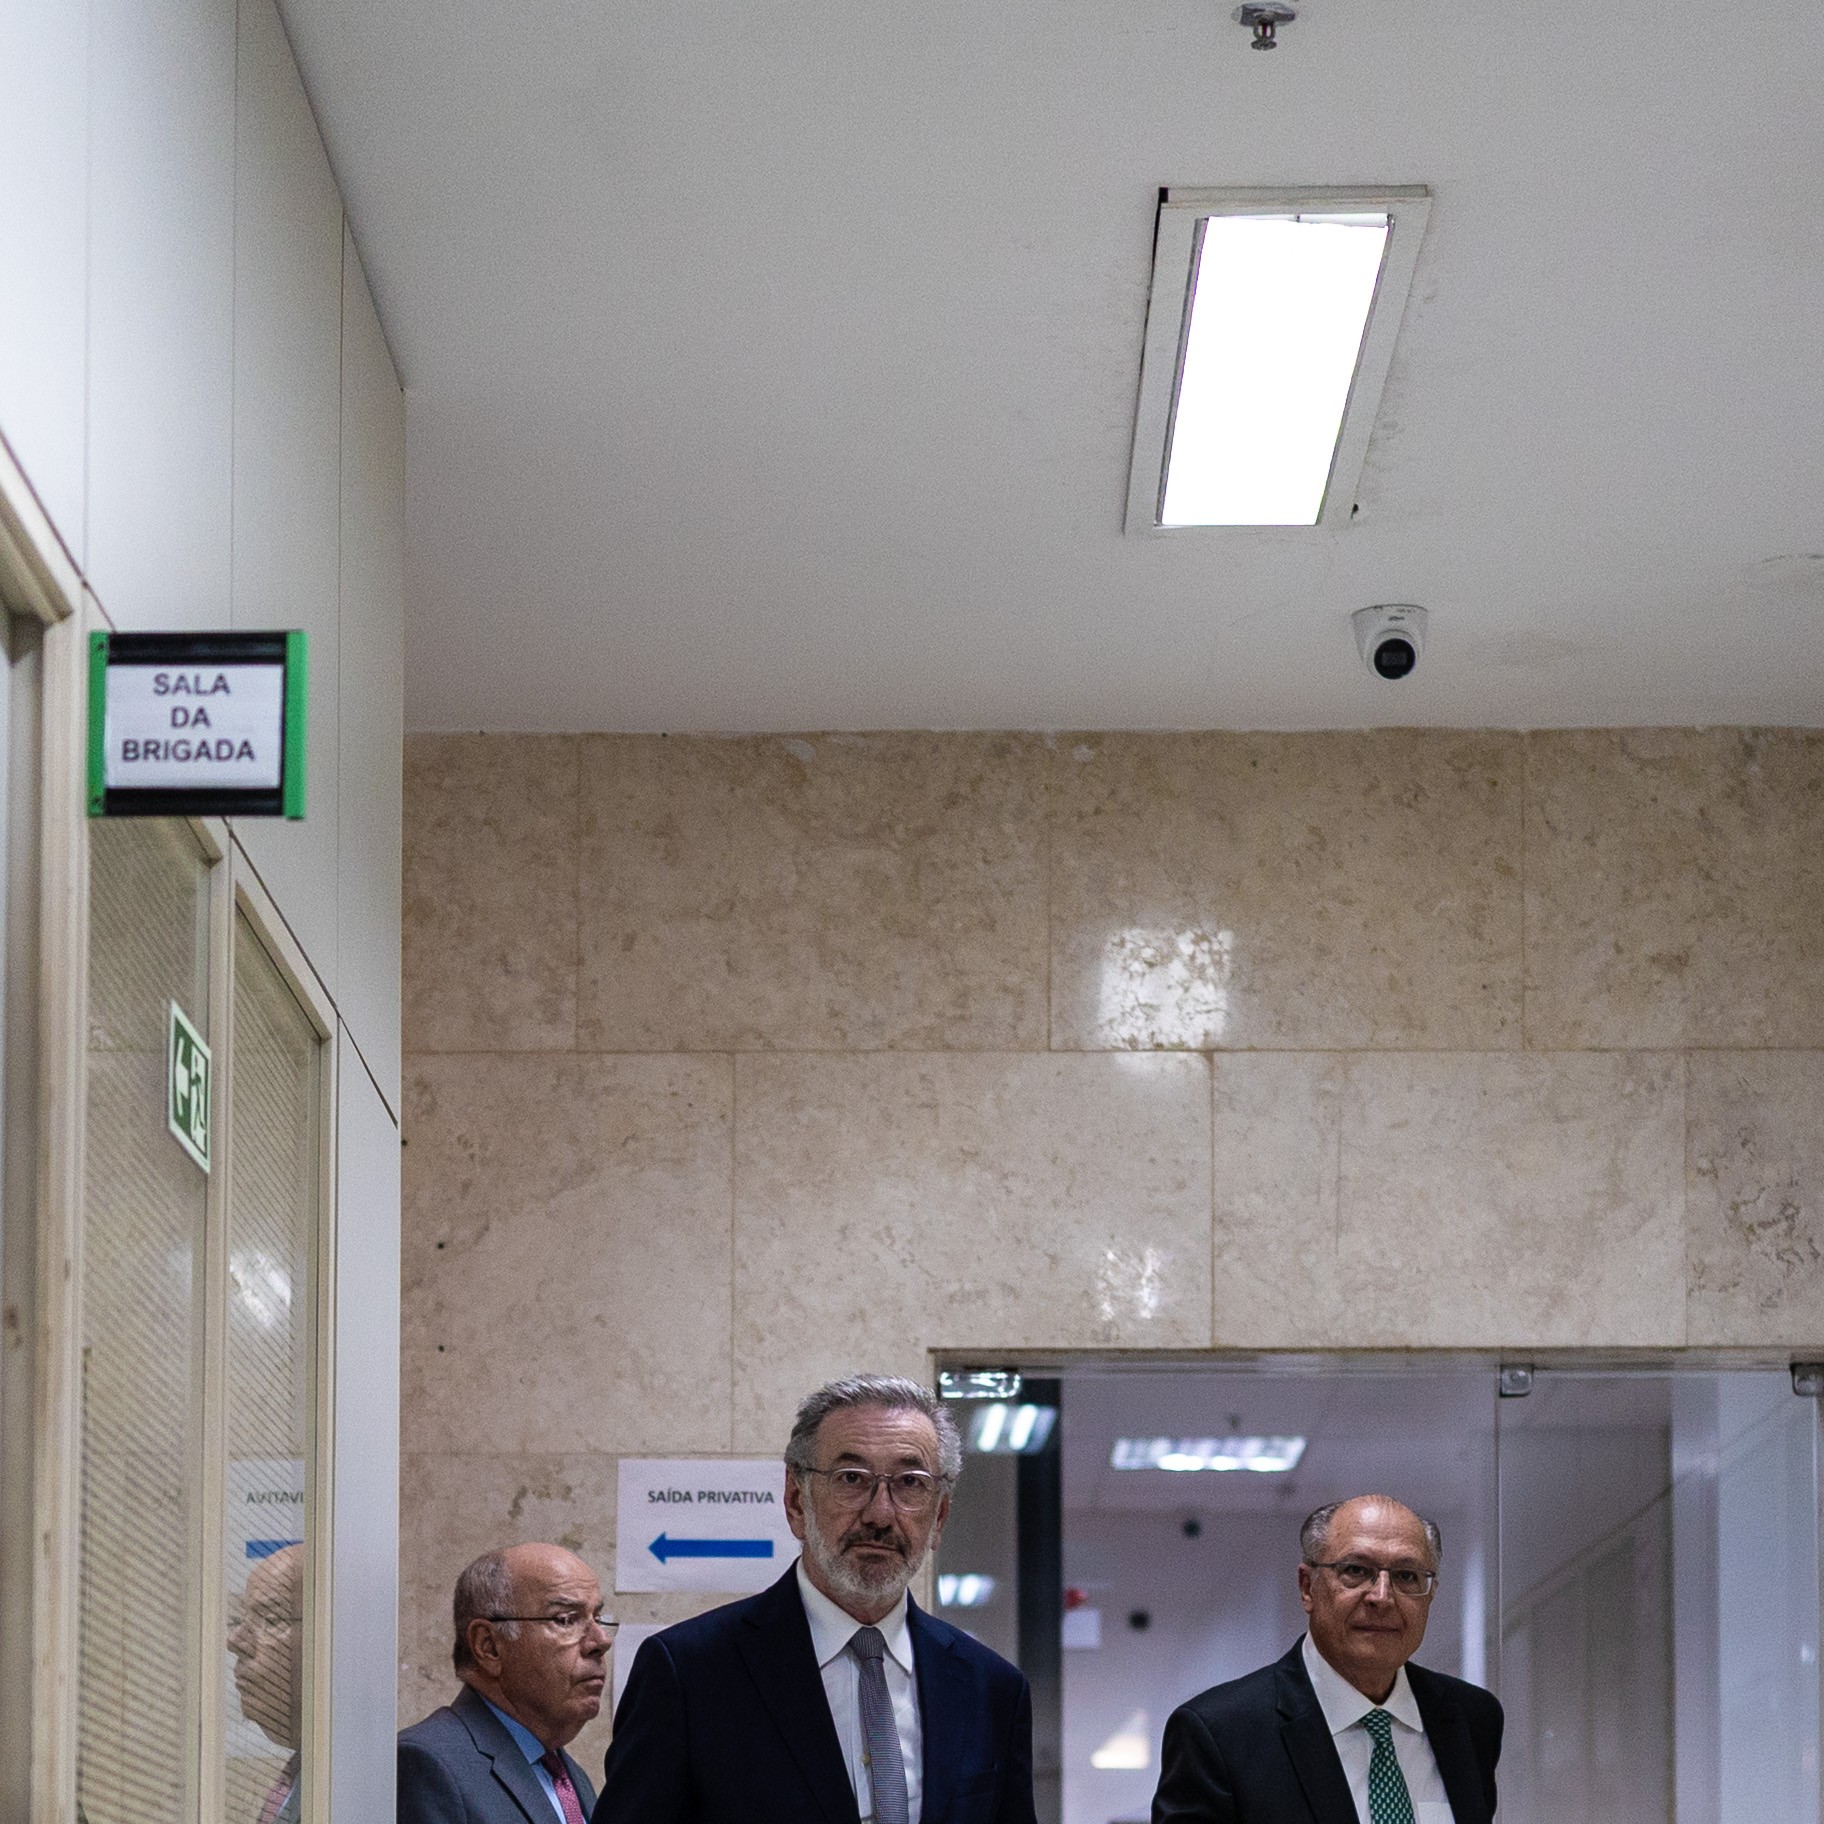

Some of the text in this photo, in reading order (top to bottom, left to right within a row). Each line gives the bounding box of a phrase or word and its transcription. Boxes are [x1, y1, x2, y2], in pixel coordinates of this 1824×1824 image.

[153, 673, 231, 696] SALA
[170, 706, 211, 728] DA
[121, 739, 256, 763] BRIGADA
[647, 1487, 775, 1504] SAÍDA PRIVATIVA
